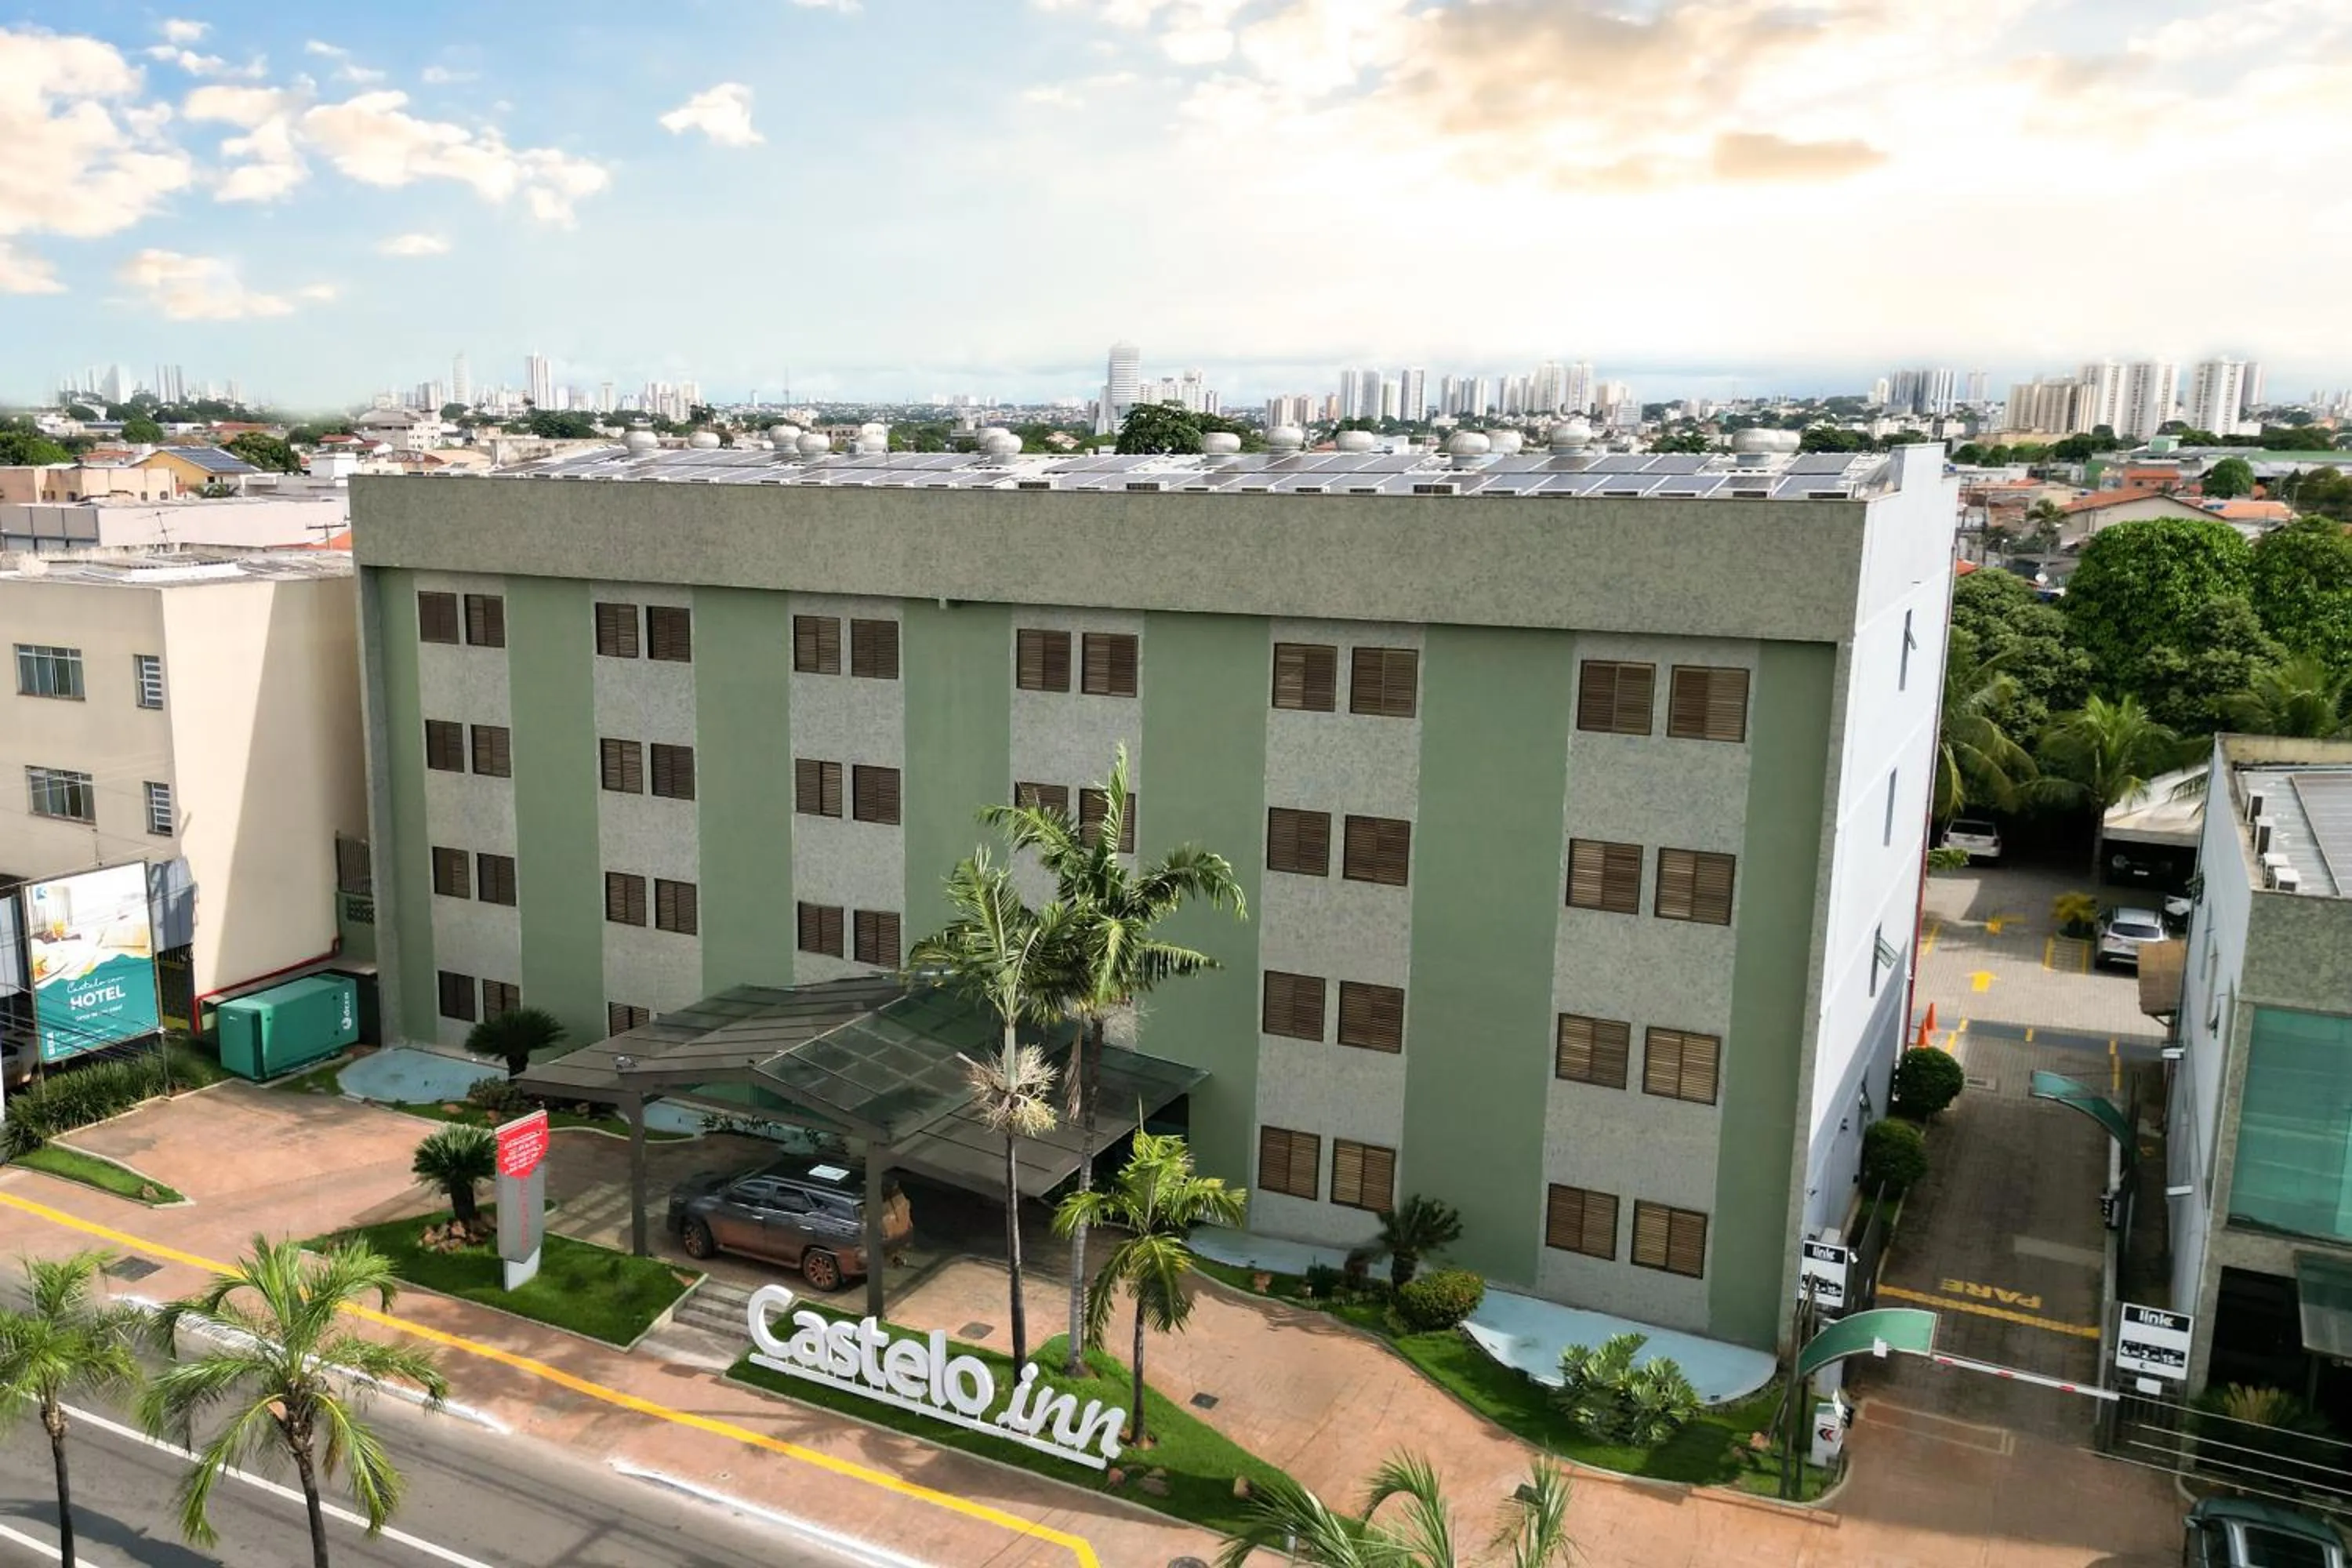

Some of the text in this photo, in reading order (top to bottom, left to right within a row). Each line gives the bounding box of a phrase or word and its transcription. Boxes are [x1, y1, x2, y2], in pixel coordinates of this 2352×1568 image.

[70, 984, 125, 1010] HOTEL
[1940, 1277, 2042, 1308] PARE
[747, 1283, 1127, 1459] Castelo inn
